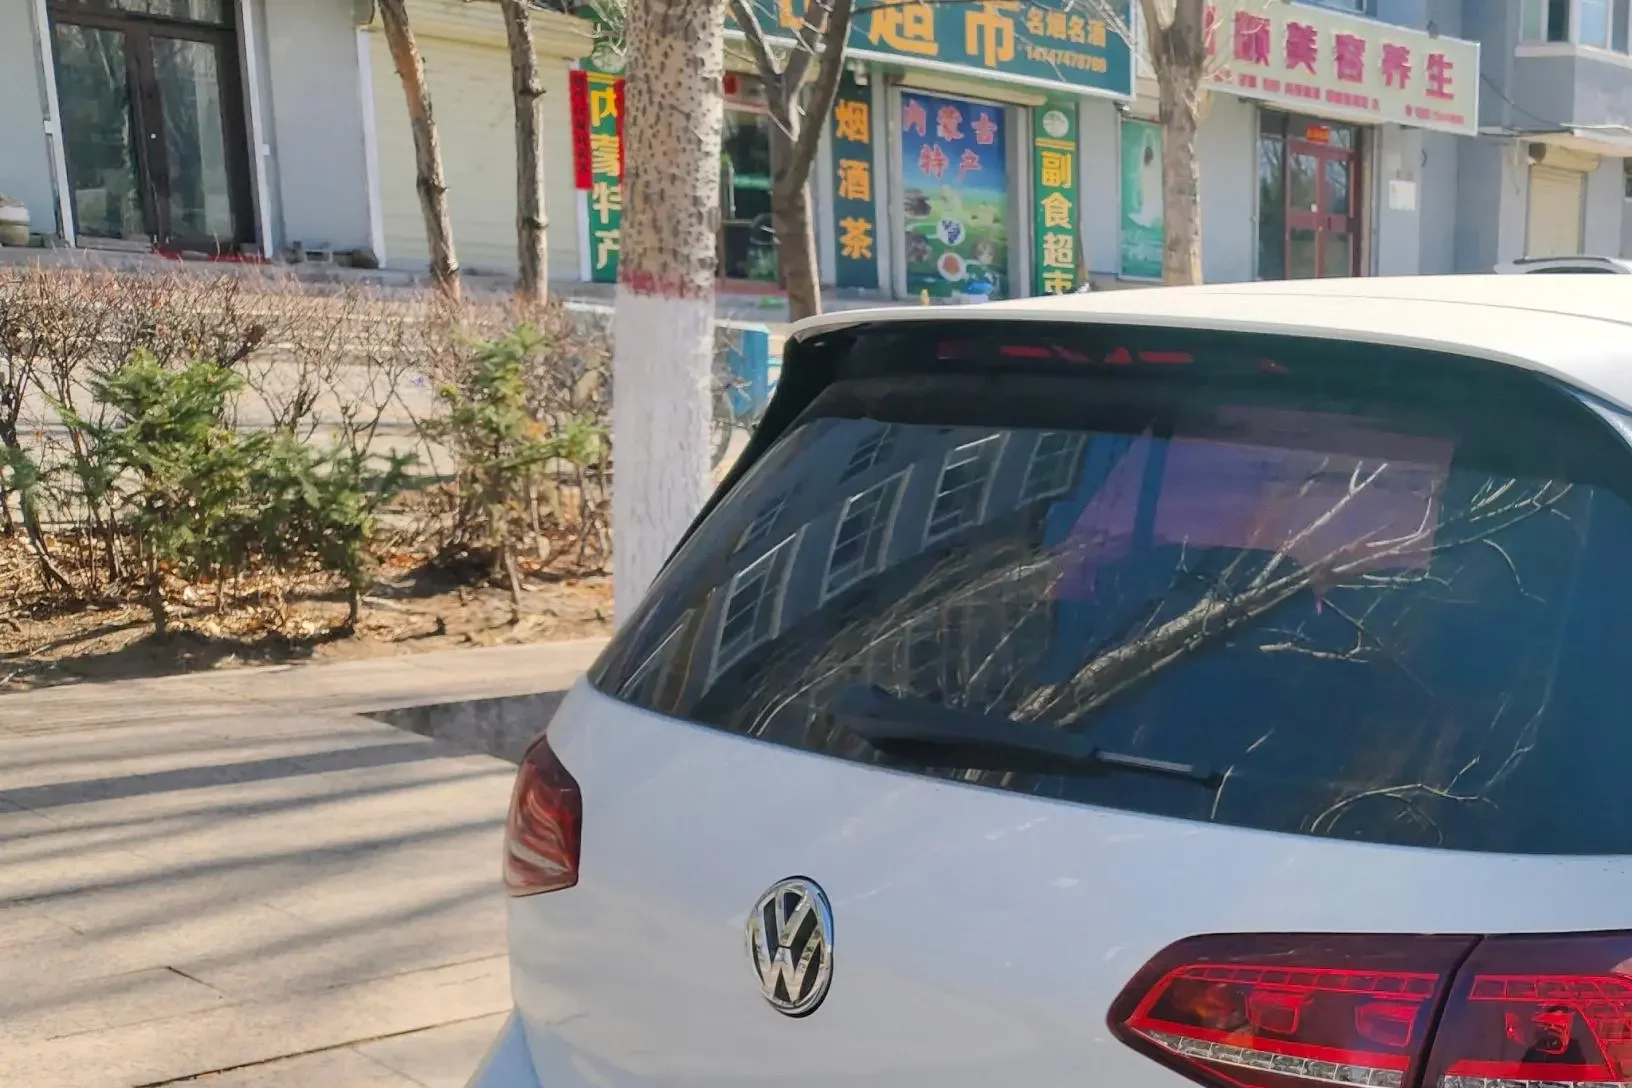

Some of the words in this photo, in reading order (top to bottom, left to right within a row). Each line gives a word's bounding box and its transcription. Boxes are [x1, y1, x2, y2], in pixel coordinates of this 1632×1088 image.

[1025, 7, 1107, 48] 名烟名酒
[903, 99, 998, 145] 内蒙古
[835, 99, 873, 260] 烟酒茶
[918, 143, 983, 181] 特产
[1040, 151, 1075, 294] 副食超市
